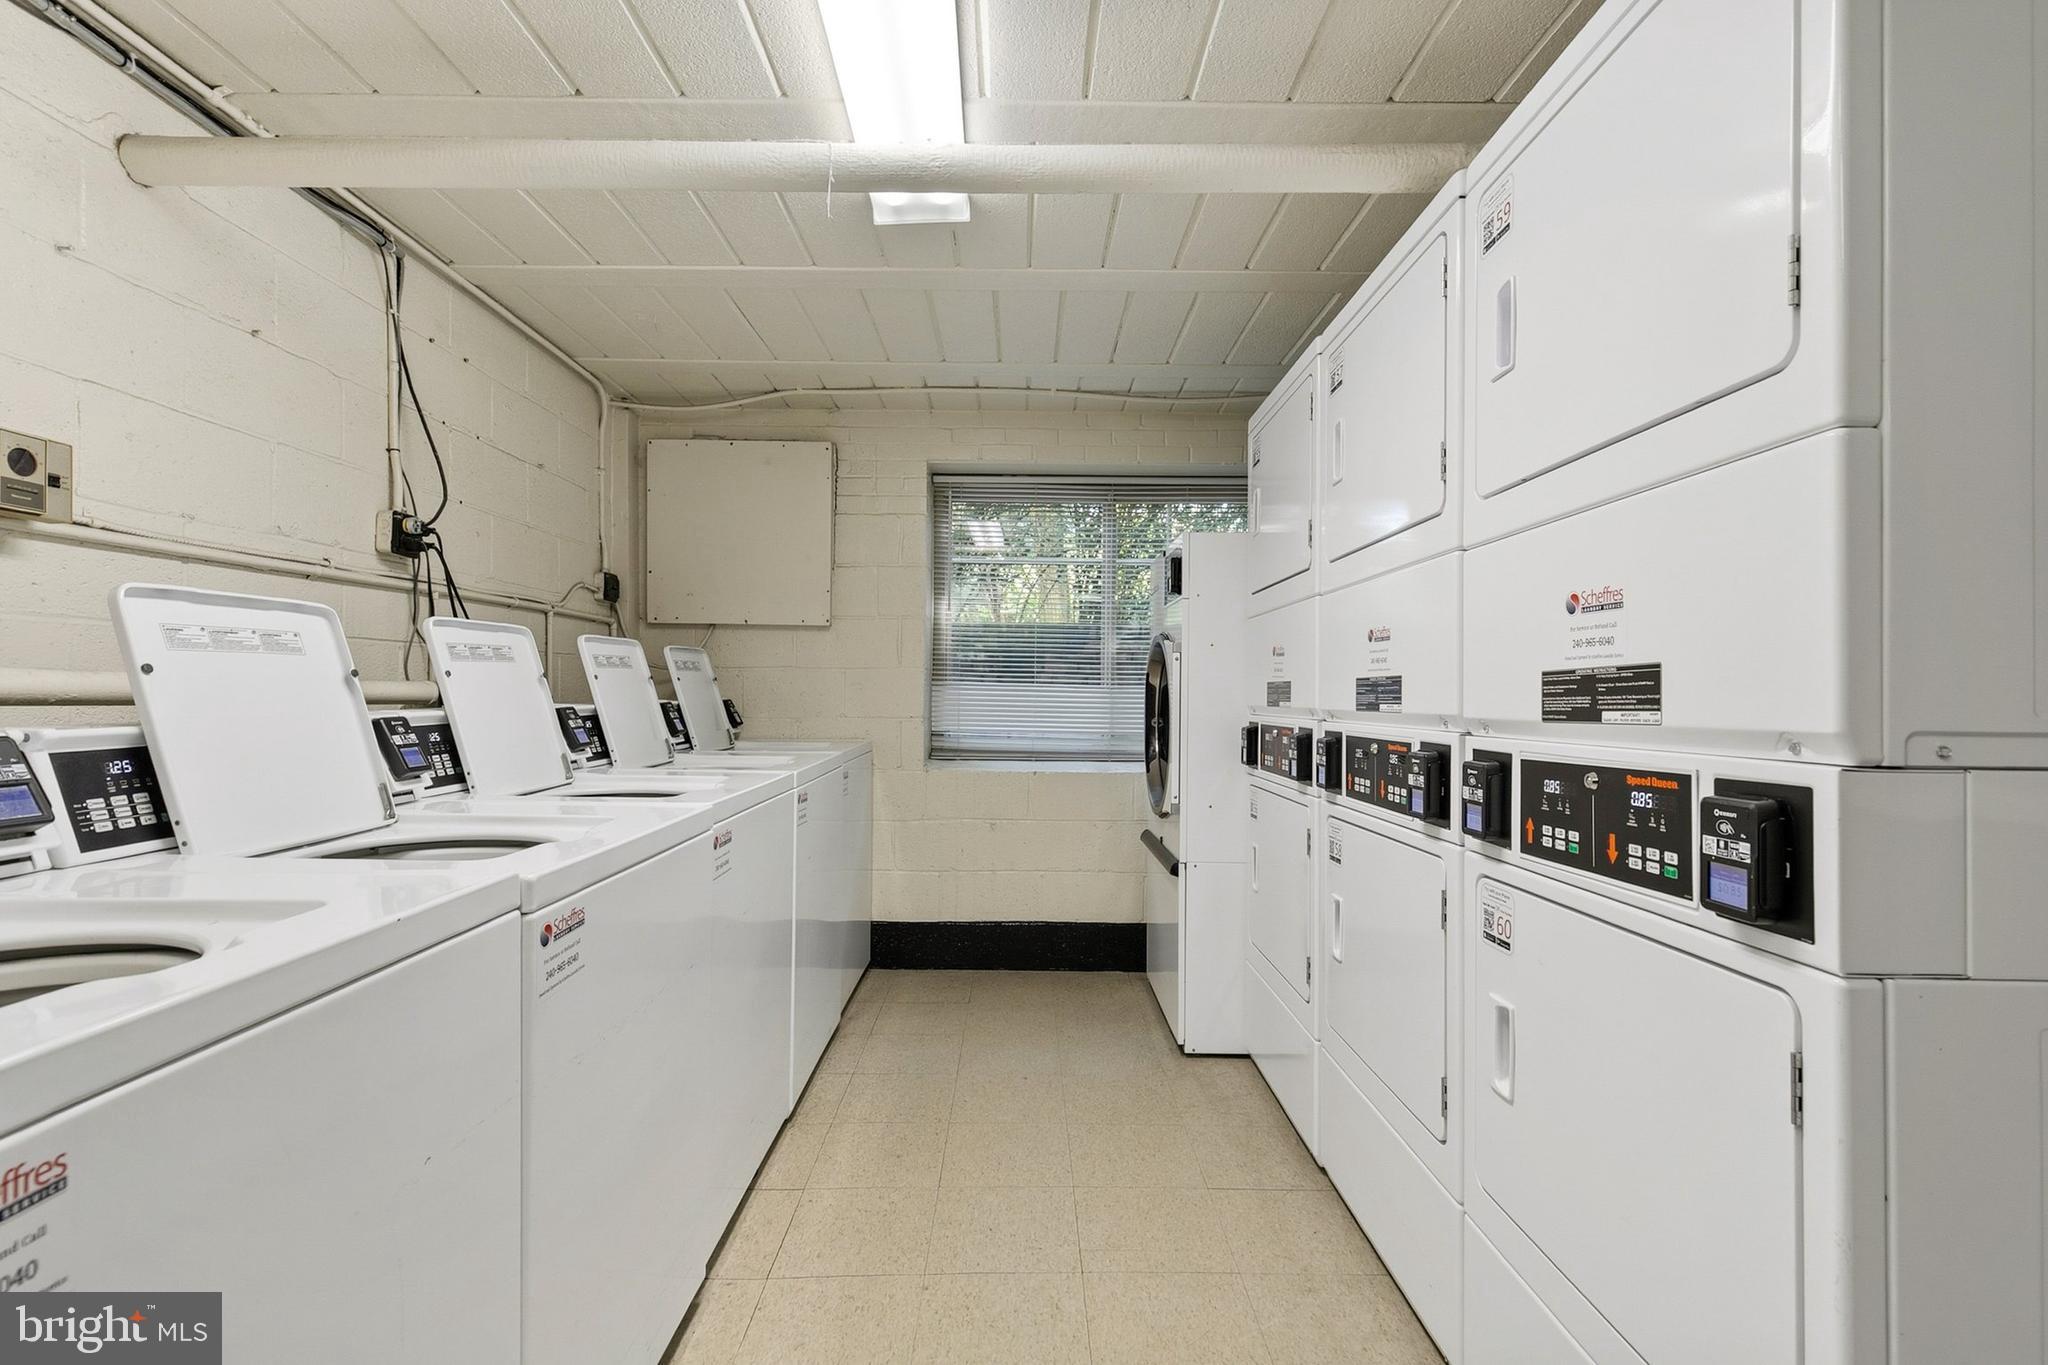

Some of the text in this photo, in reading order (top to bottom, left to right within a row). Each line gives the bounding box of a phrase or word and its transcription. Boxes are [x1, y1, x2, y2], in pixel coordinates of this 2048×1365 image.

[1496, 201, 1511, 231] 59
[1581, 585, 1624, 606] Scheffres
[1572, 635, 1615, 648] 240-965-6040
[1626, 774, 1679, 789] Speed Queen
[553, 906, 585, 934] Scheffres
[1497, 916, 1512, 939] 60
